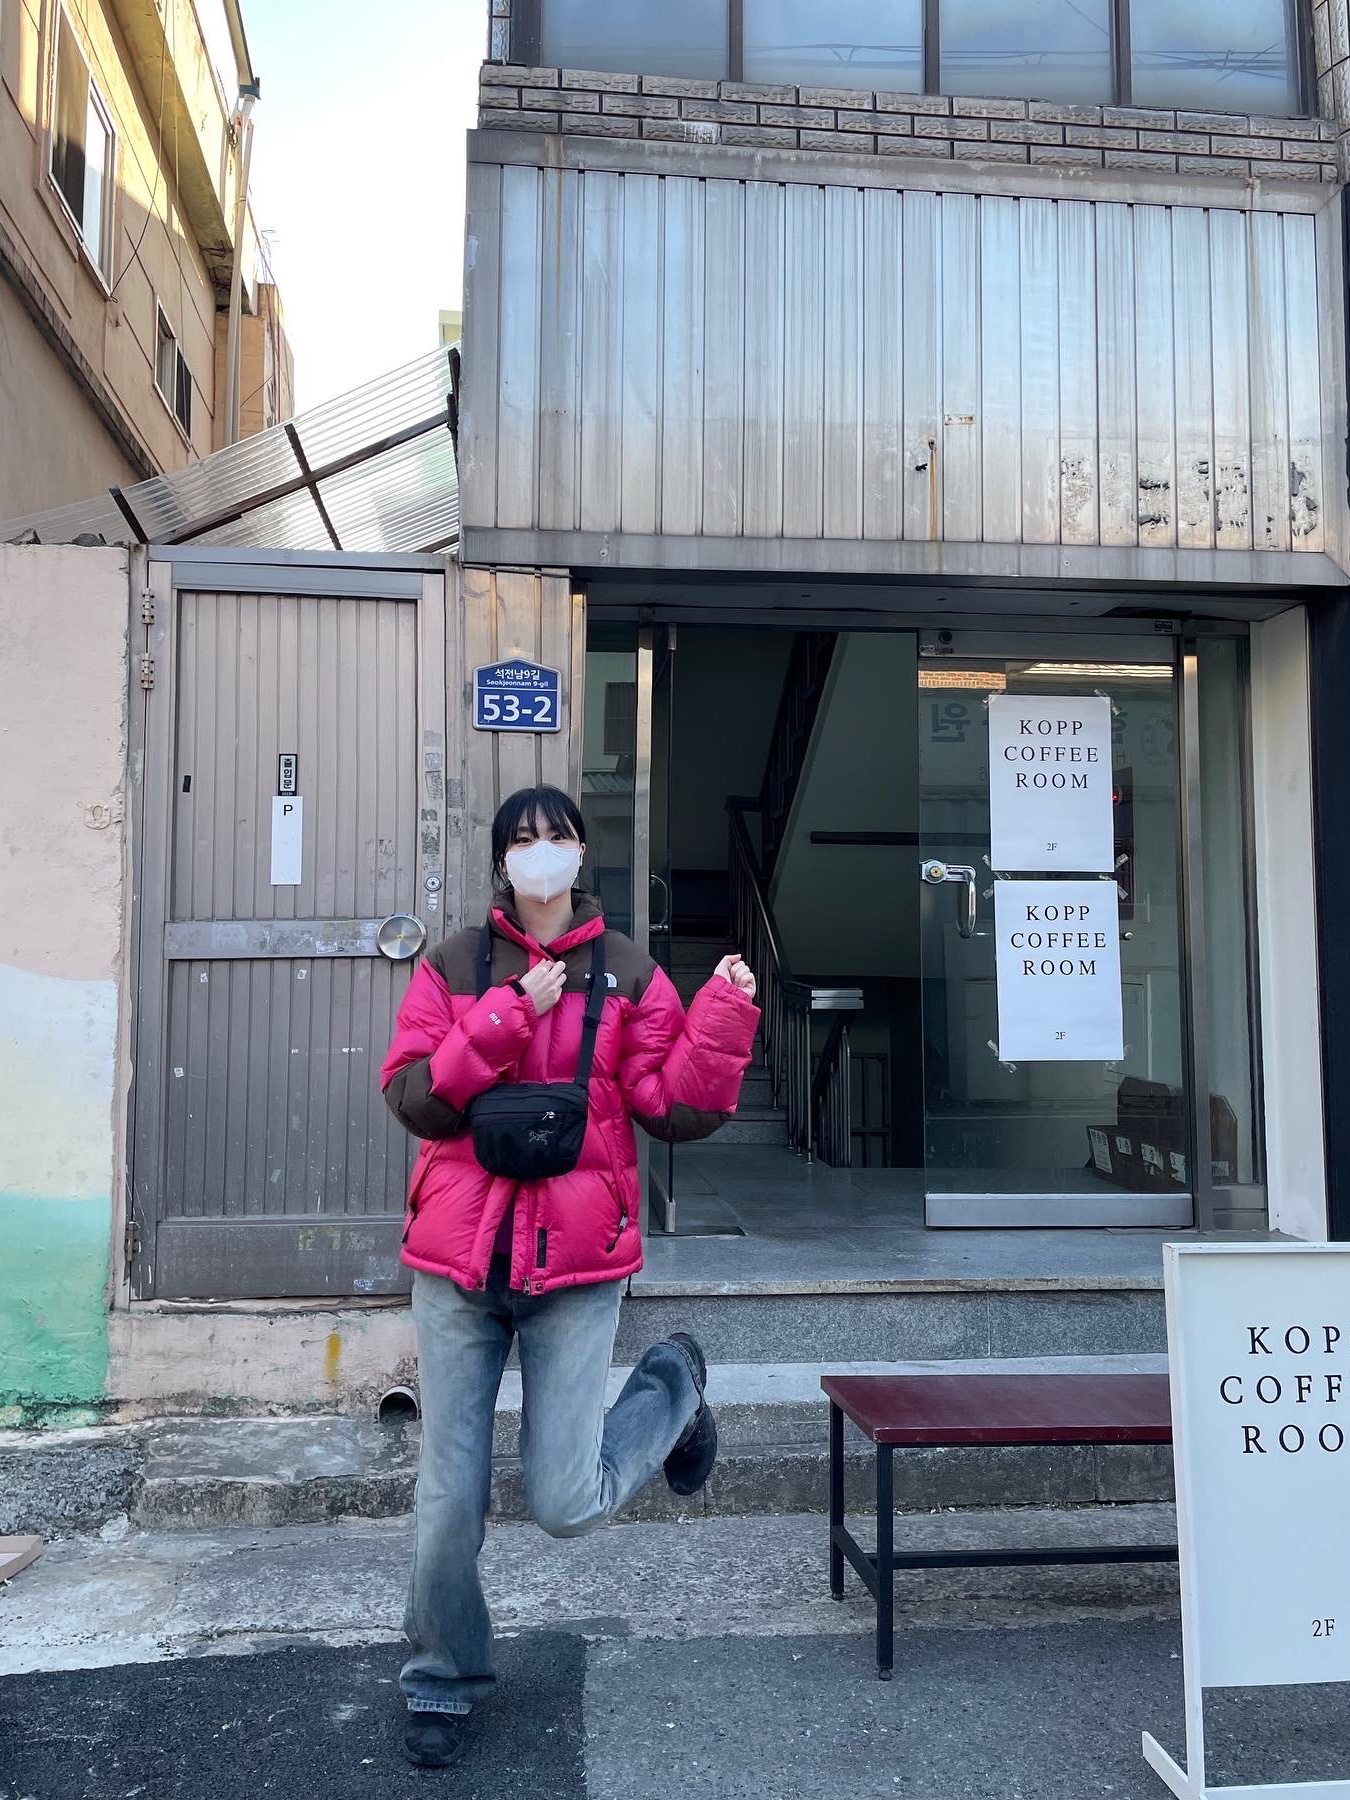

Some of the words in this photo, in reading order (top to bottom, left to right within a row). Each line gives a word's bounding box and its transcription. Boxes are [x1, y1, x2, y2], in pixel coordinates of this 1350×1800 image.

[495, 668, 540, 680] 석전남9길
[486, 679, 531, 687] Seokjeonnam
[483, 694, 552, 723] 53-2
[1019, 719, 1083, 736] KOPP
[1003, 746, 1099, 763] COFFEE
[1015, 772, 1089, 789] ROOM
[283, 804, 294, 816] P
[1046, 842, 1057, 851] 2F
[1025, 905, 1090, 921] KOPP
[1010, 932, 1107, 948] COFFEE
[1022, 960, 1097, 976] ROOM
[1055, 1032, 1066, 1040] 2F
[1246, 1326, 1341, 1354] KOP
[1219, 1374, 1342, 1404] COFF
[1241, 1423, 1344, 1454] ROO
[1311, 1618, 1336, 1637] 2F
